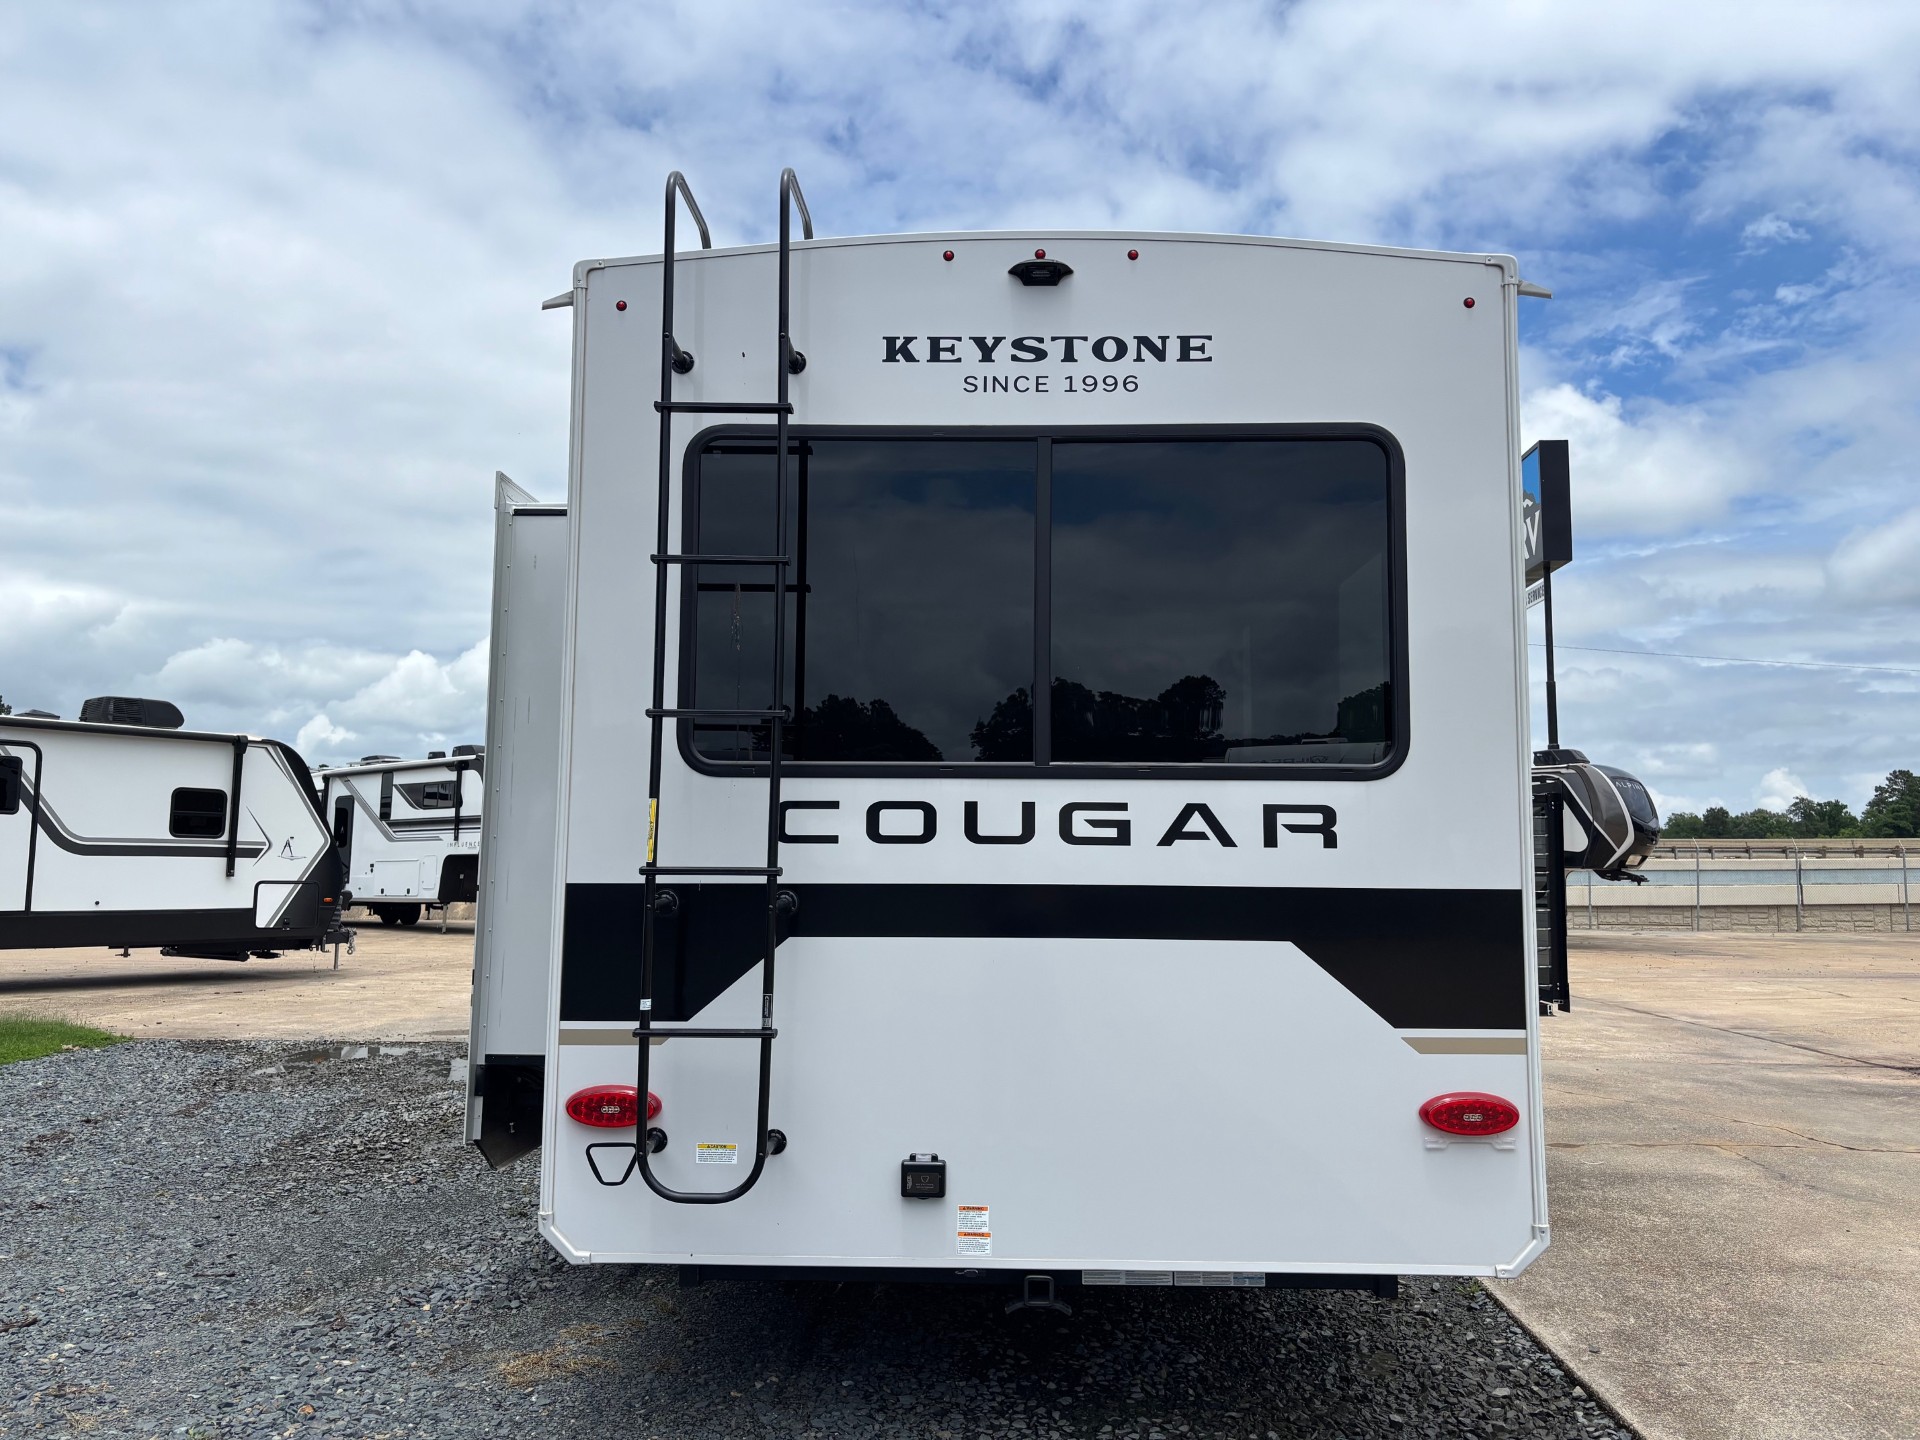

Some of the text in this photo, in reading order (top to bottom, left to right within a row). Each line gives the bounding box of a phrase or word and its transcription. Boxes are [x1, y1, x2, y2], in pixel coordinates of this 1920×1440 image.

[882, 335, 1213, 363] KEYSTONE
[962, 374, 1139, 393] SINCE 1996
[777, 800, 1338, 849] COUGAR
